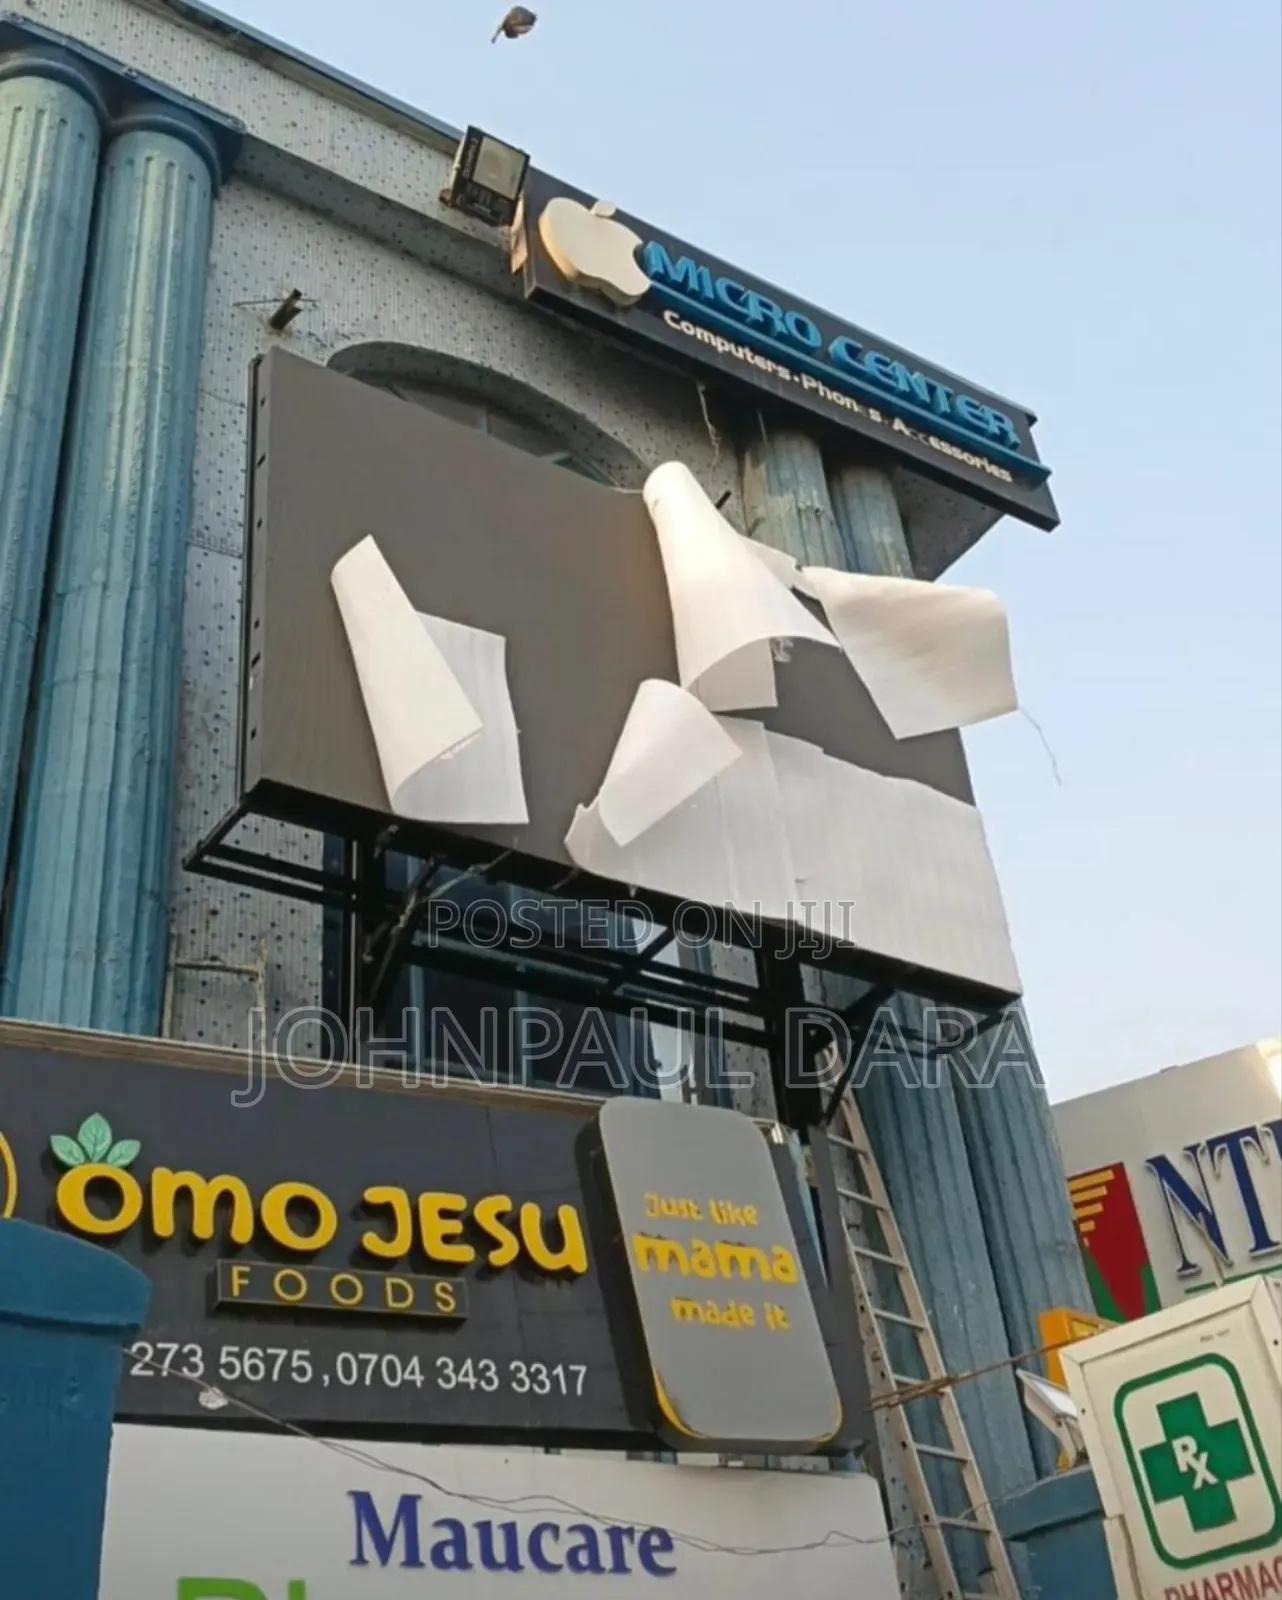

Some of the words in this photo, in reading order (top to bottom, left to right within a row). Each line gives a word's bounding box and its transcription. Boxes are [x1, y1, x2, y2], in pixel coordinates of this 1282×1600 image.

[643, 240, 822, 348] MICRO
[828, 334, 1021, 449] CENTER
[801, 373, 883, 423] Phons
[709, 1197, 759, 1227] like
[1145, 1118, 1282, 1278] NT
[632, 1233, 799, 1284] mama
[230, 1265, 457, 1313] FOODS
[669, 1297, 757, 1329] made
[763, 1302, 792, 1331] it
[435, 1355, 499, 1394] 343
[510, 1360, 588, 1397] 3317
[347, 1490, 677, 1577] Maucare
